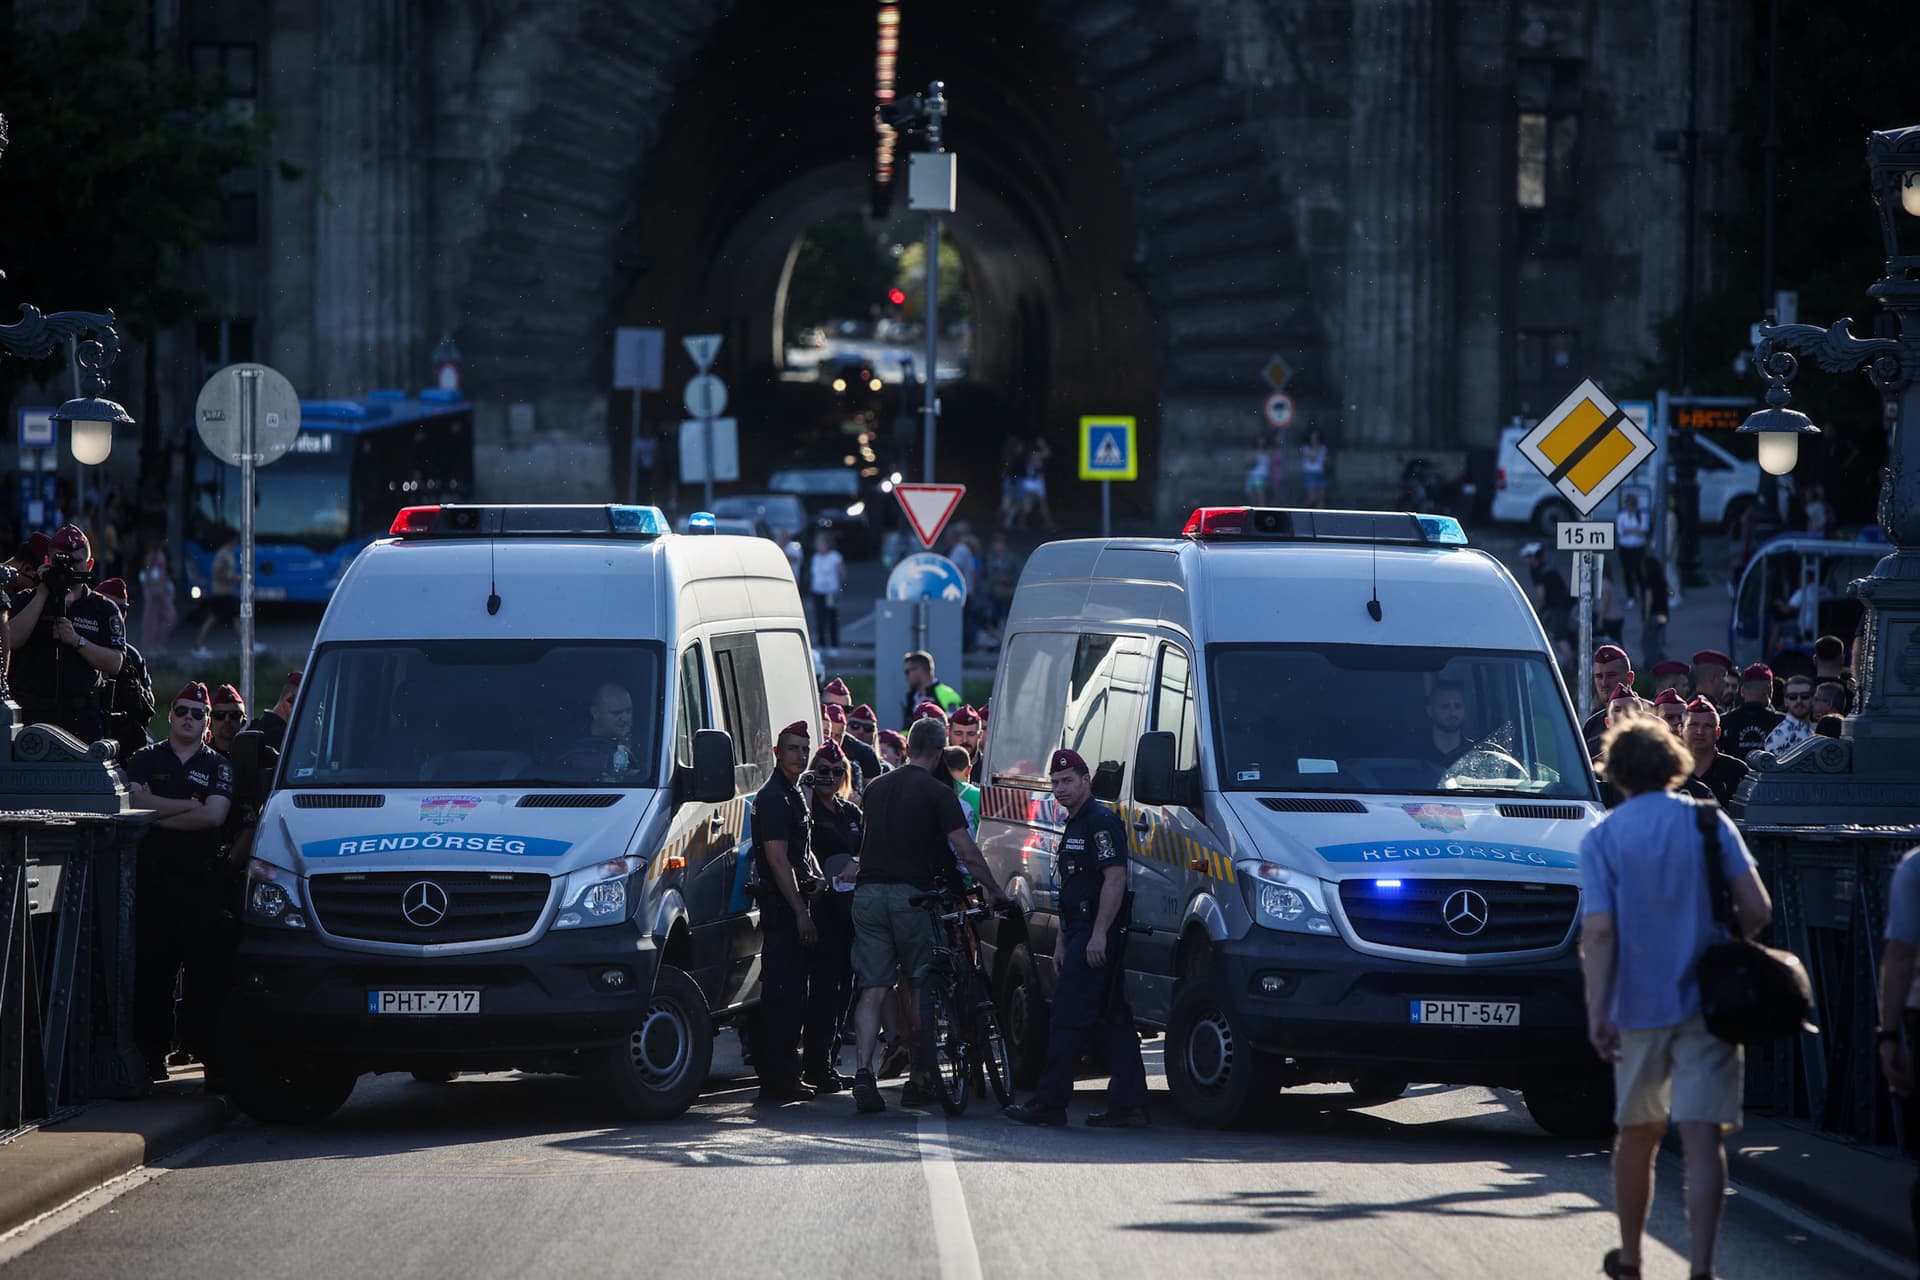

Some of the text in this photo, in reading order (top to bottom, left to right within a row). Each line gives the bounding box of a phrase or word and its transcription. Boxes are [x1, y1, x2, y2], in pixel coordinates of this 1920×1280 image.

[1564, 527, 1605, 545] 15 m
[338, 832, 527, 856] RENDŐRSÉG
[382, 993, 475, 1012] PHT-717
[1425, 1002, 1516, 1023] PHT-547
